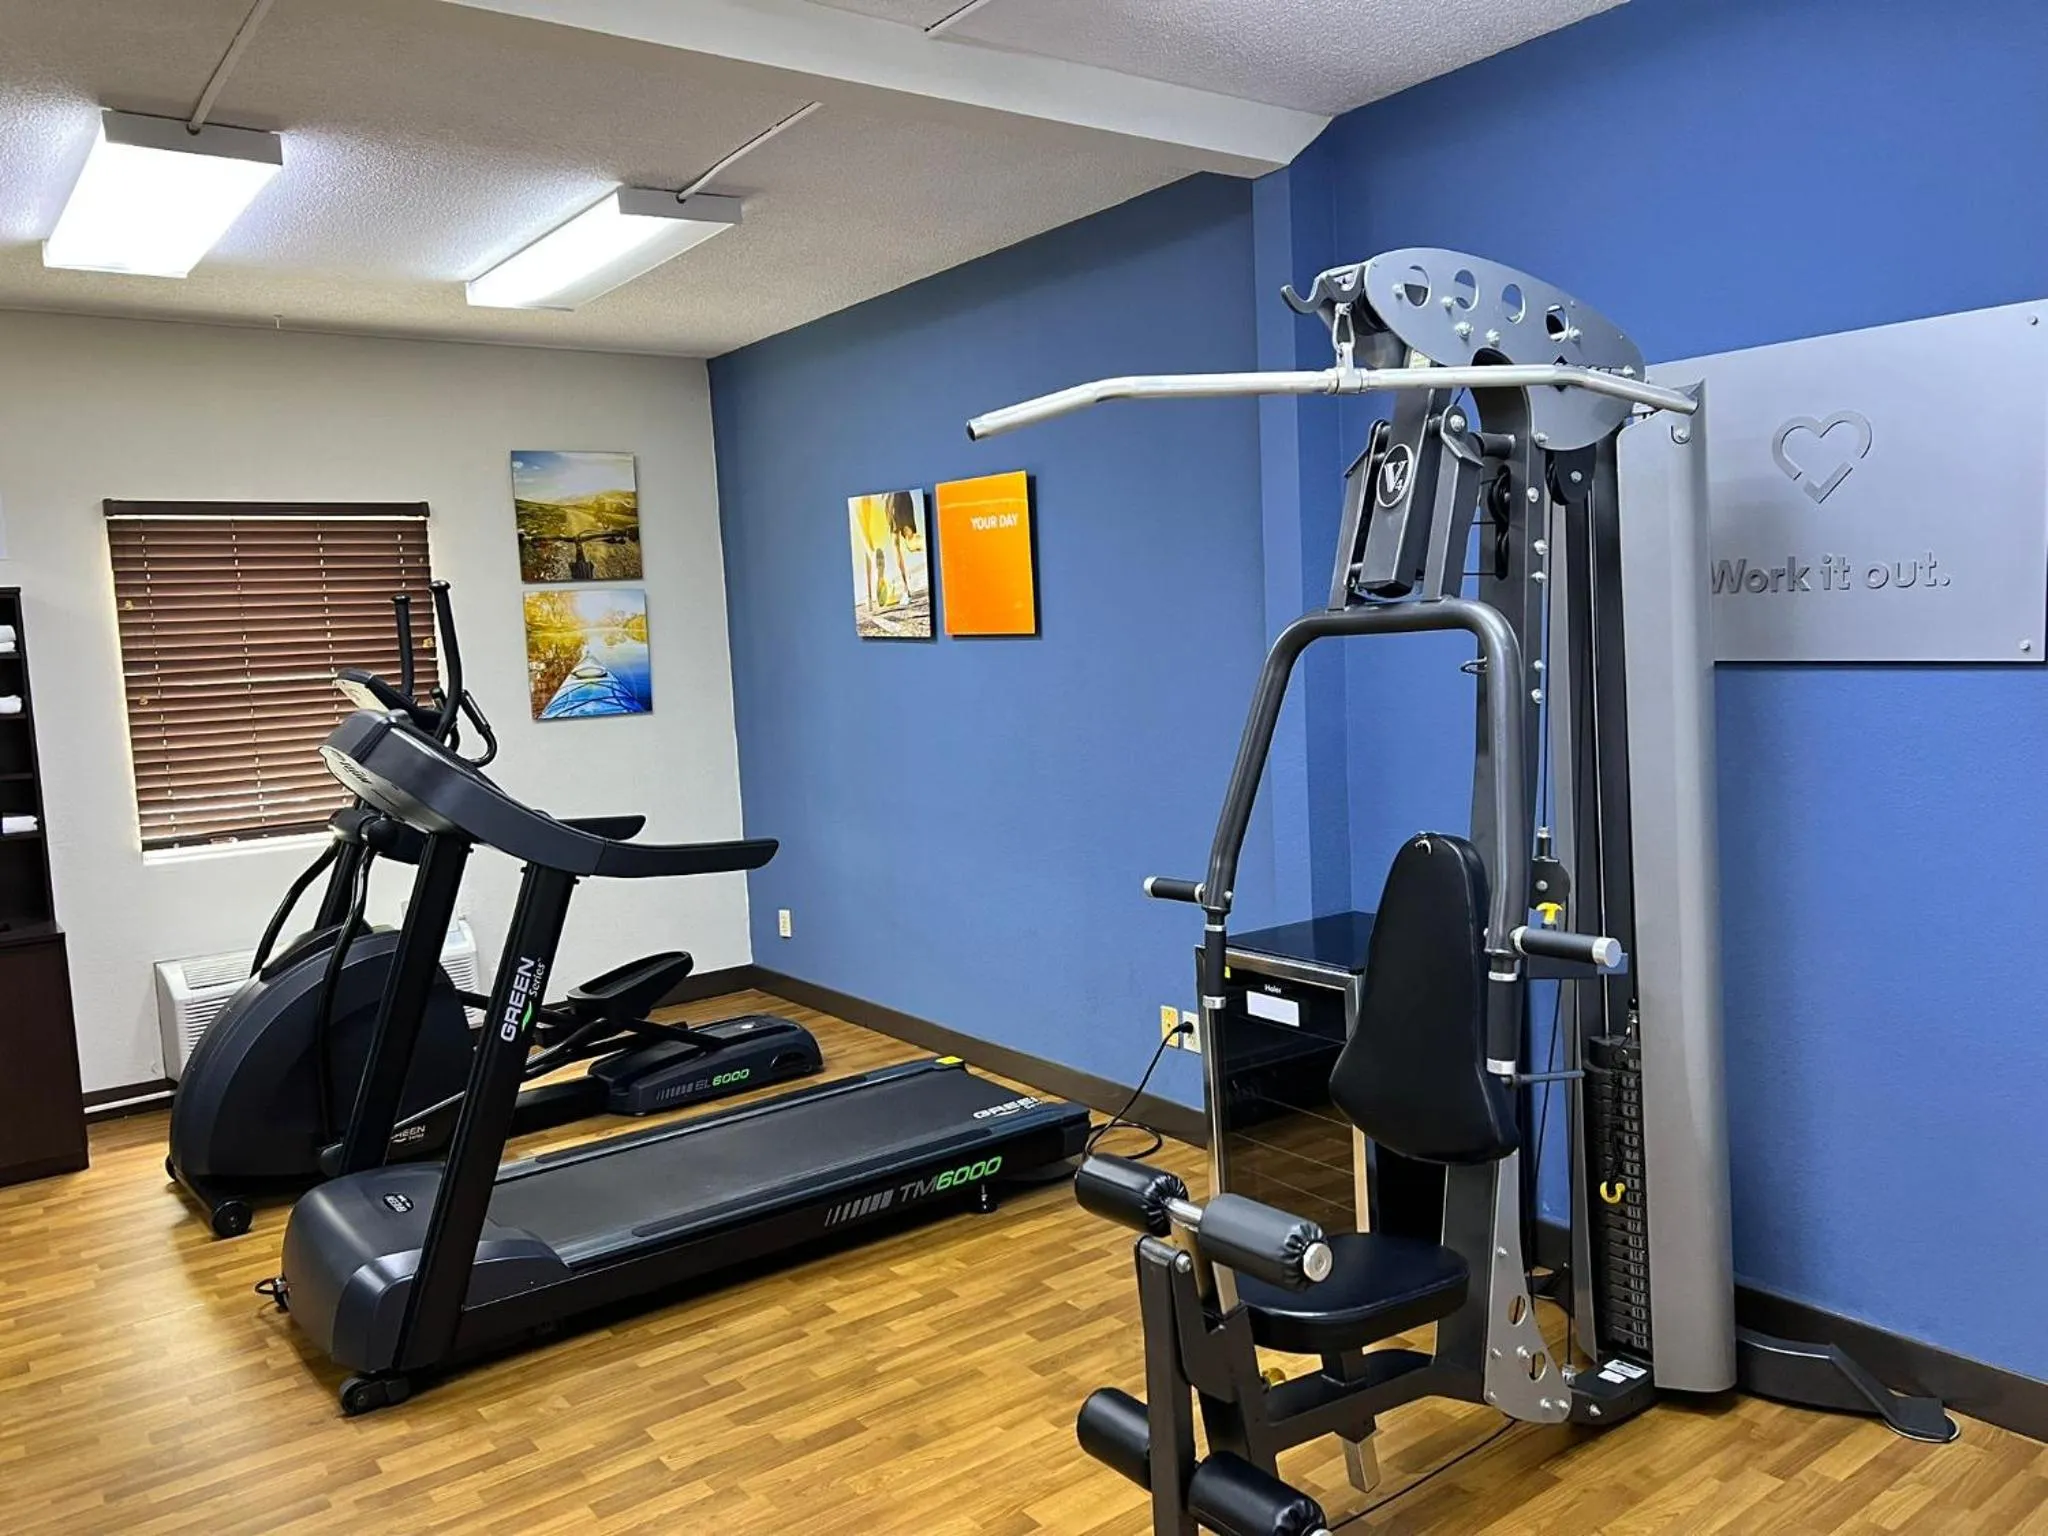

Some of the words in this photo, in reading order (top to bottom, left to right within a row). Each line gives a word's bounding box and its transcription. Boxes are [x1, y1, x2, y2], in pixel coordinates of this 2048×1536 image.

[971, 515, 998, 530] YOUR
[999, 513, 1018, 527] DAY
[1710, 556, 1811, 594] Work
[1820, 554, 1851, 590] it
[1866, 551, 1951, 590] out.
[500, 956, 535, 1042] GREEN
[1264, 984, 1281, 994] Haier
[900, 1155, 1002, 1202] TM6000
